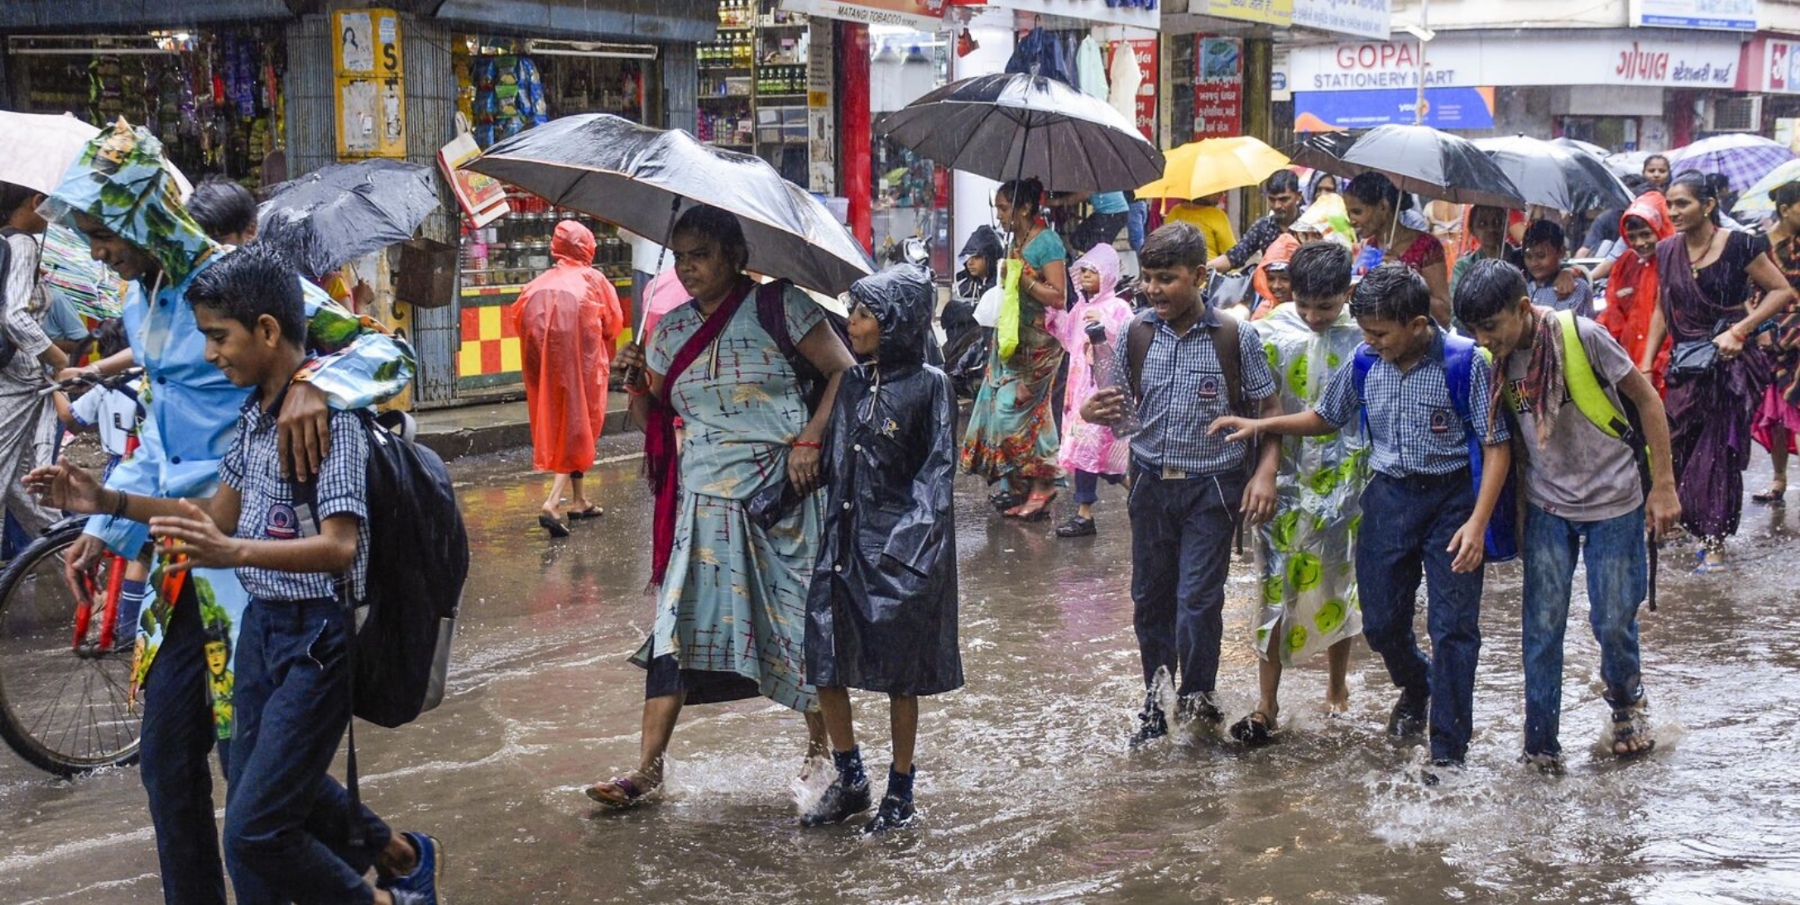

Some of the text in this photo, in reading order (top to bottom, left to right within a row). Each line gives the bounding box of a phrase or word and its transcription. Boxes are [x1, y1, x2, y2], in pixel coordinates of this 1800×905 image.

[837, 6, 867, 20] MATANGI
[869, 11, 902, 25] TOBACCO
[1337, 42, 1431, 69] GOPAL
[1616, 42, 1669, 80] ગોપાલ
[1314, 71, 1407, 88] STATIONERY
